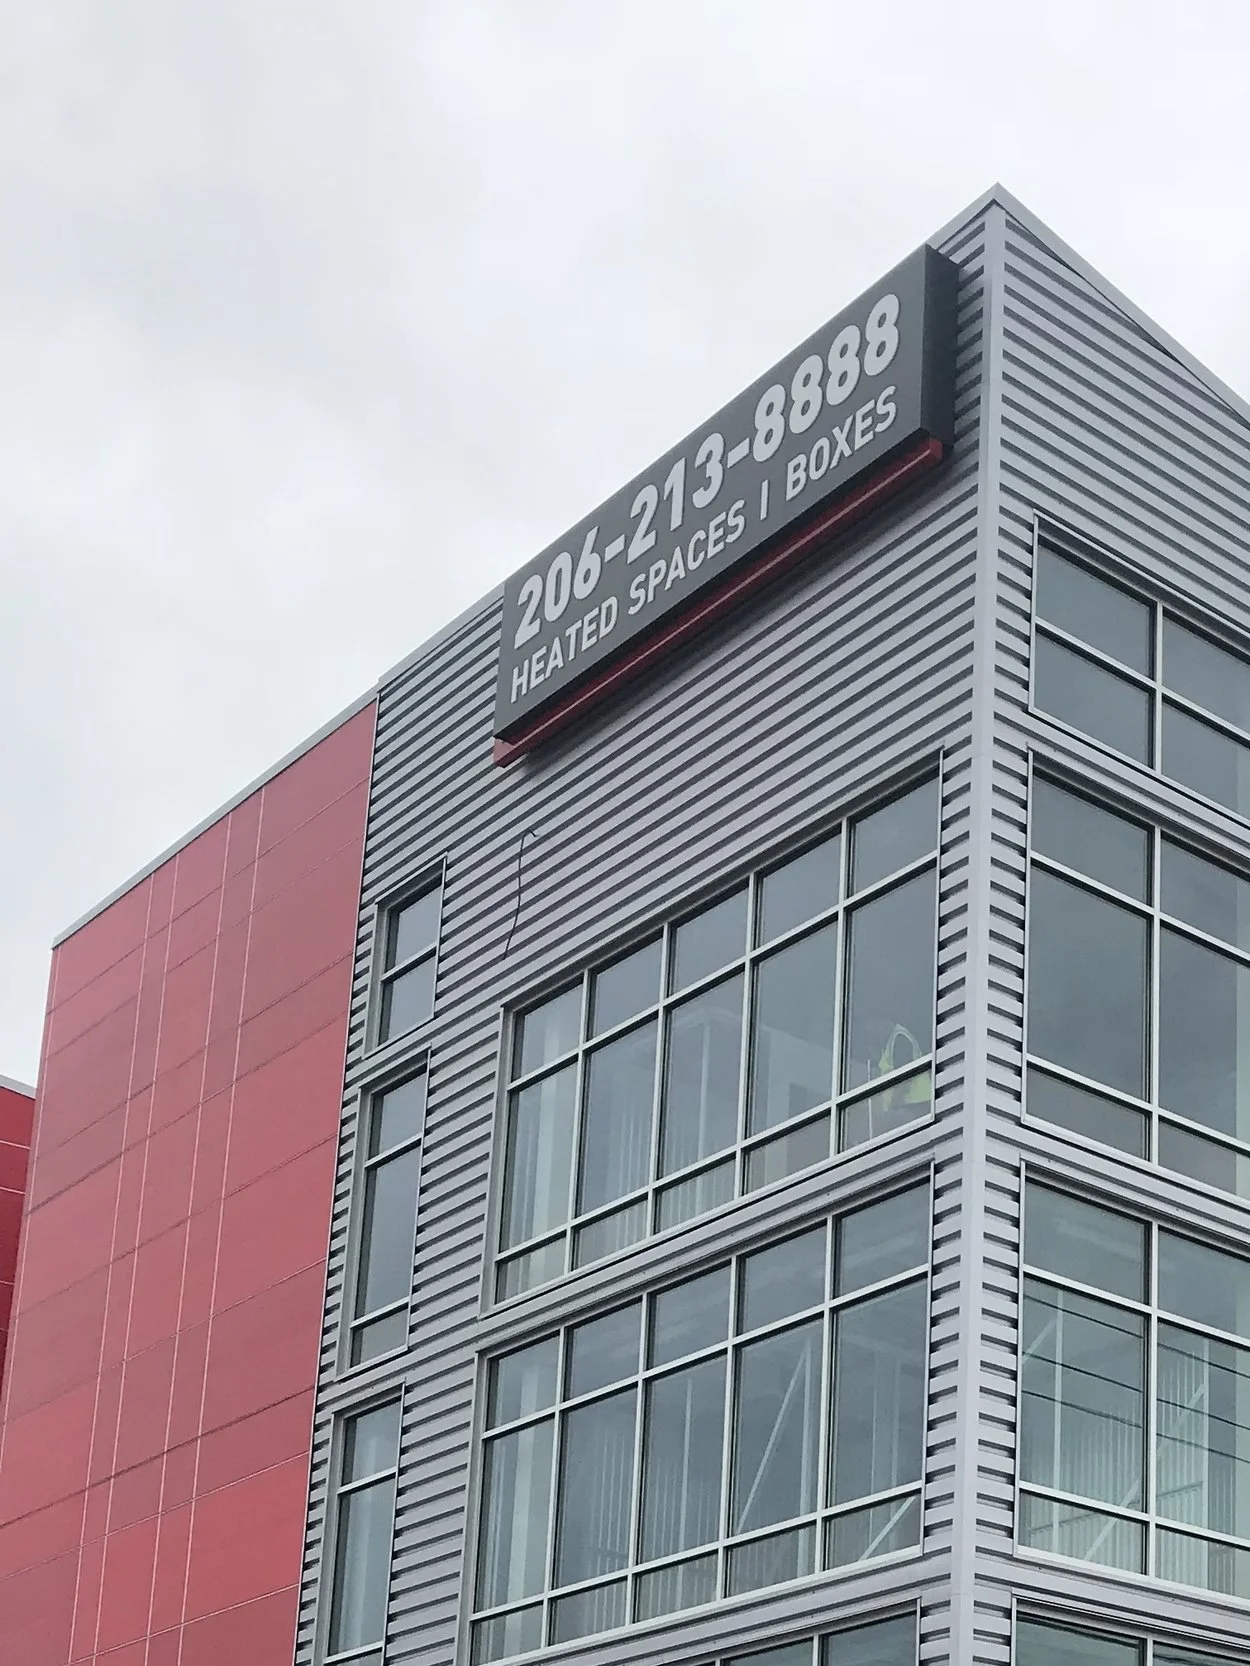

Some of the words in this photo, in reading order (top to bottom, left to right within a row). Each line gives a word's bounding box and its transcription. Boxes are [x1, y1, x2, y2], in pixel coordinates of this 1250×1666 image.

[510, 596, 617, 703] HEATED
[628, 501, 745, 616] SPACES
[786, 386, 896, 501] BOXES
[514, 294, 899, 649] 206-213-8888
